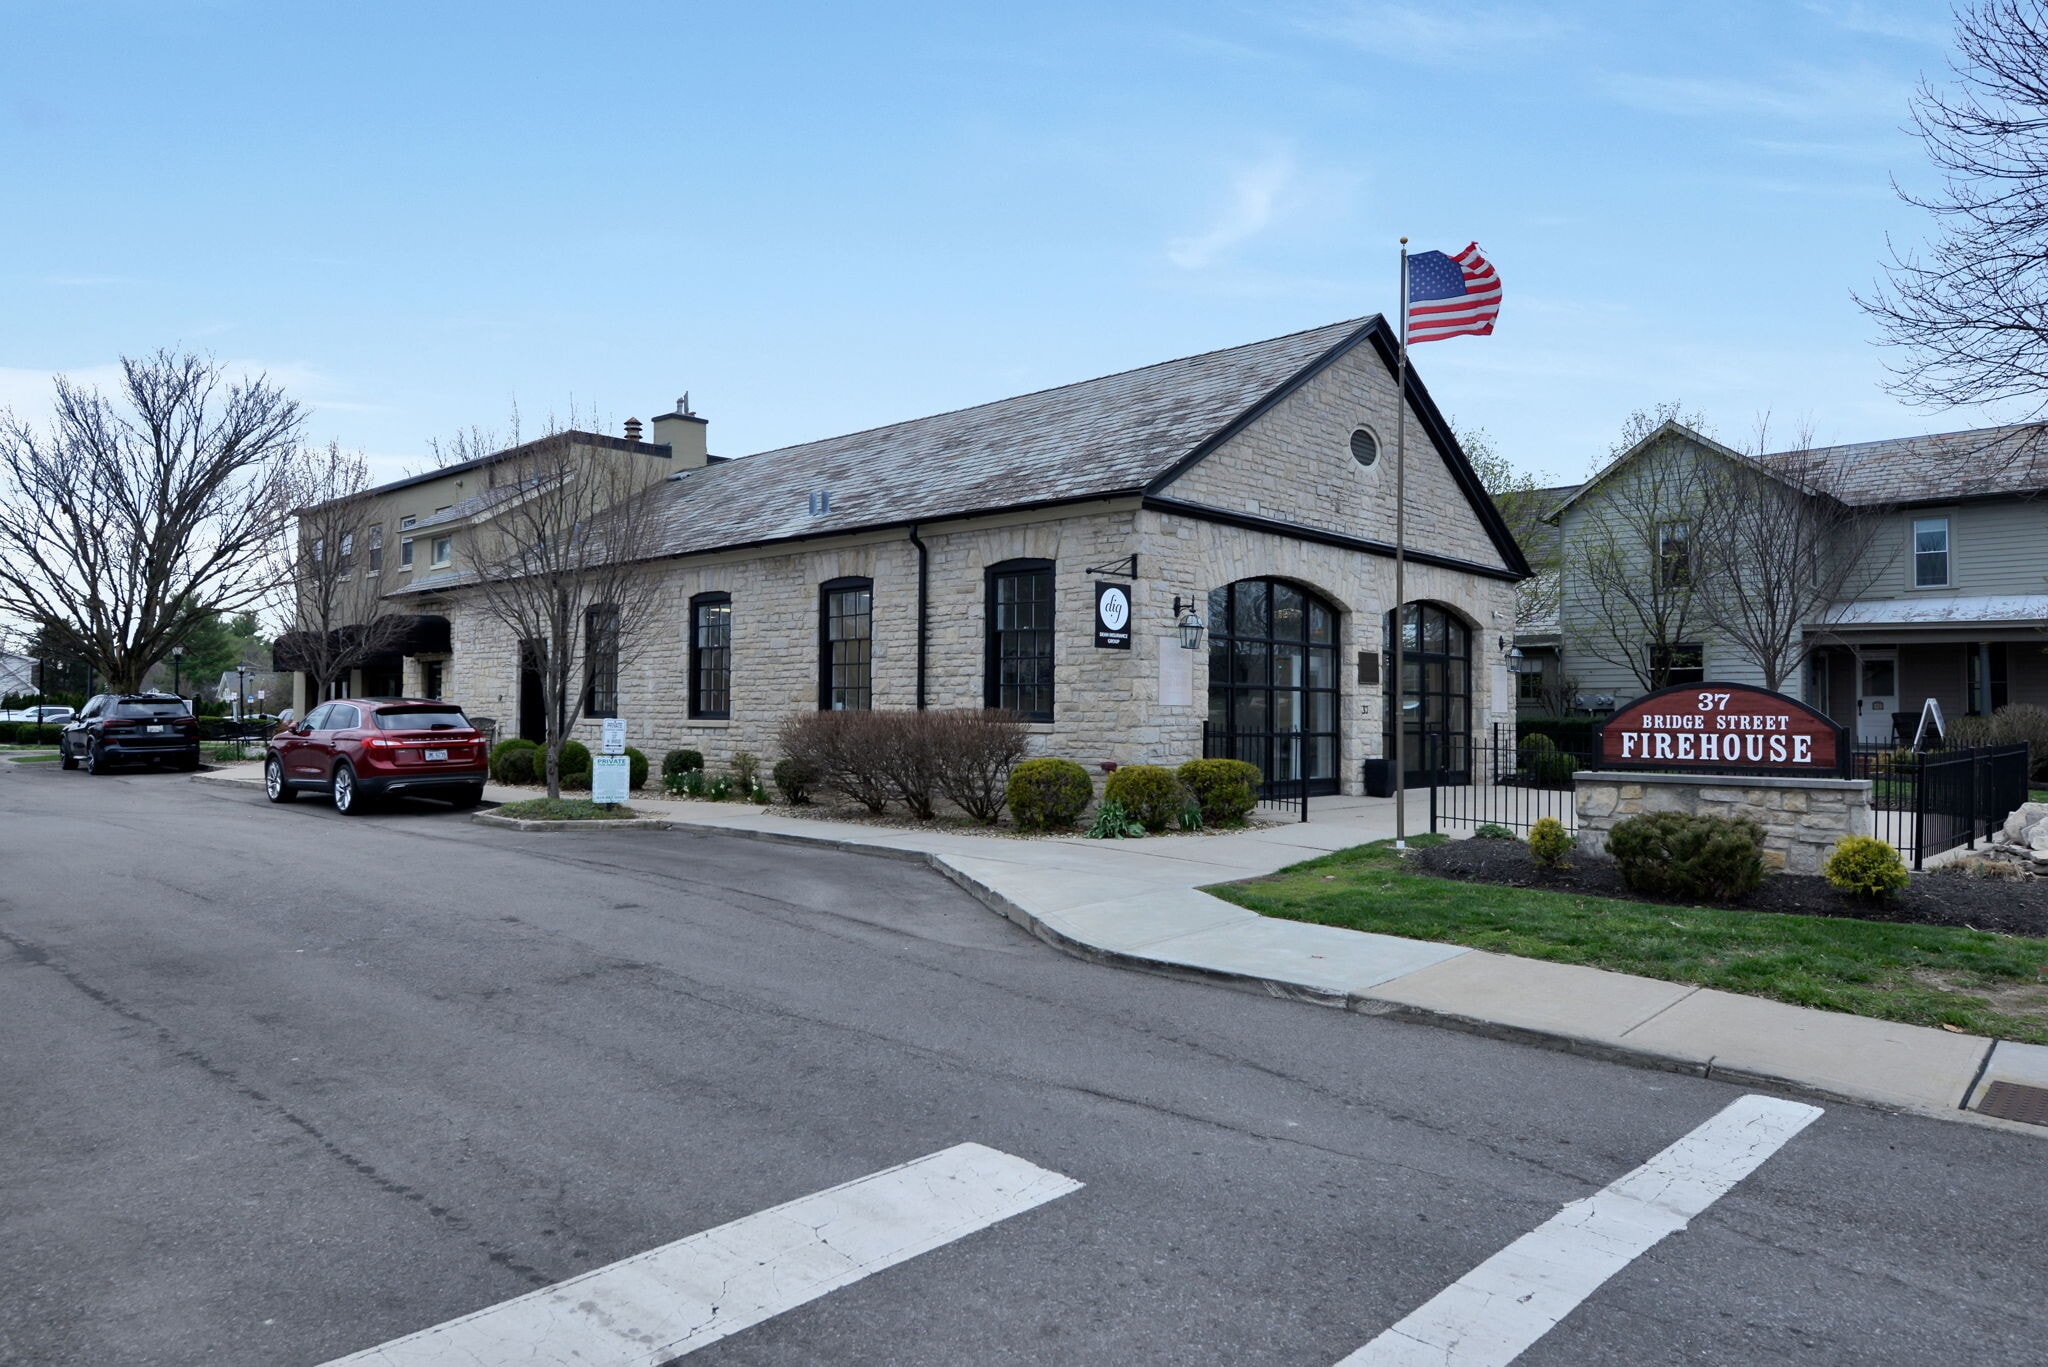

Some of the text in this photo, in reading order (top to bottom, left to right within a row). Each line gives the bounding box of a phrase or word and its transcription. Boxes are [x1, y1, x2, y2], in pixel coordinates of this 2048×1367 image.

[1105, 594, 1122, 624] dig
[1698, 692, 1730, 711] 37
[1642, 715, 1789, 730] BRIDGE STREET
[1621, 732, 1812, 763] FIREHOUSE
